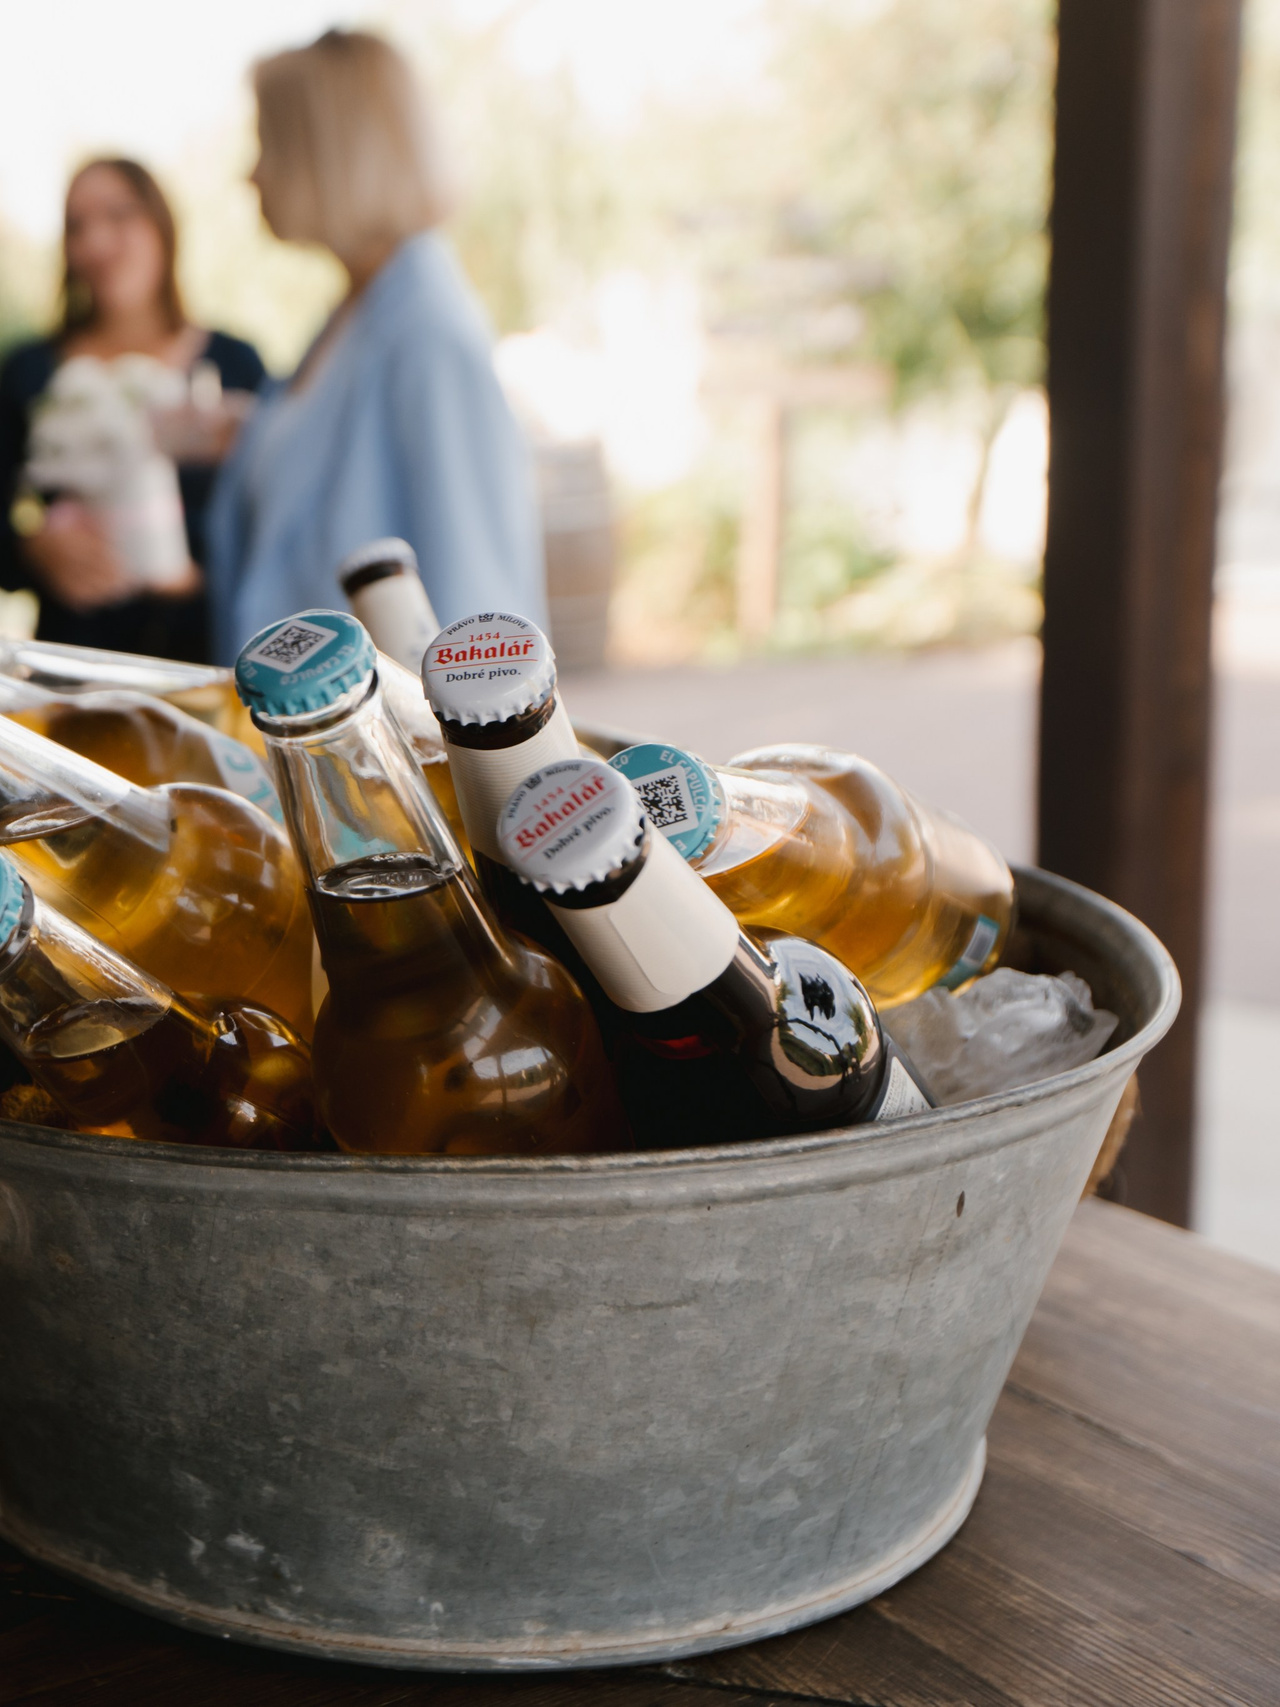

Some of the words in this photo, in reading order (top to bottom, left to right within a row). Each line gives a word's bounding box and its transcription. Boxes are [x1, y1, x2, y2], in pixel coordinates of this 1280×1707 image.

[468, 632, 500, 643] 1454
[433, 639, 535, 665] Bakalář
[445, 668, 485, 683] Dobré
[488, 667, 521, 680] pivo.
[659, 750, 676, 764] EL
[677, 759, 706, 813] CAPULCO
